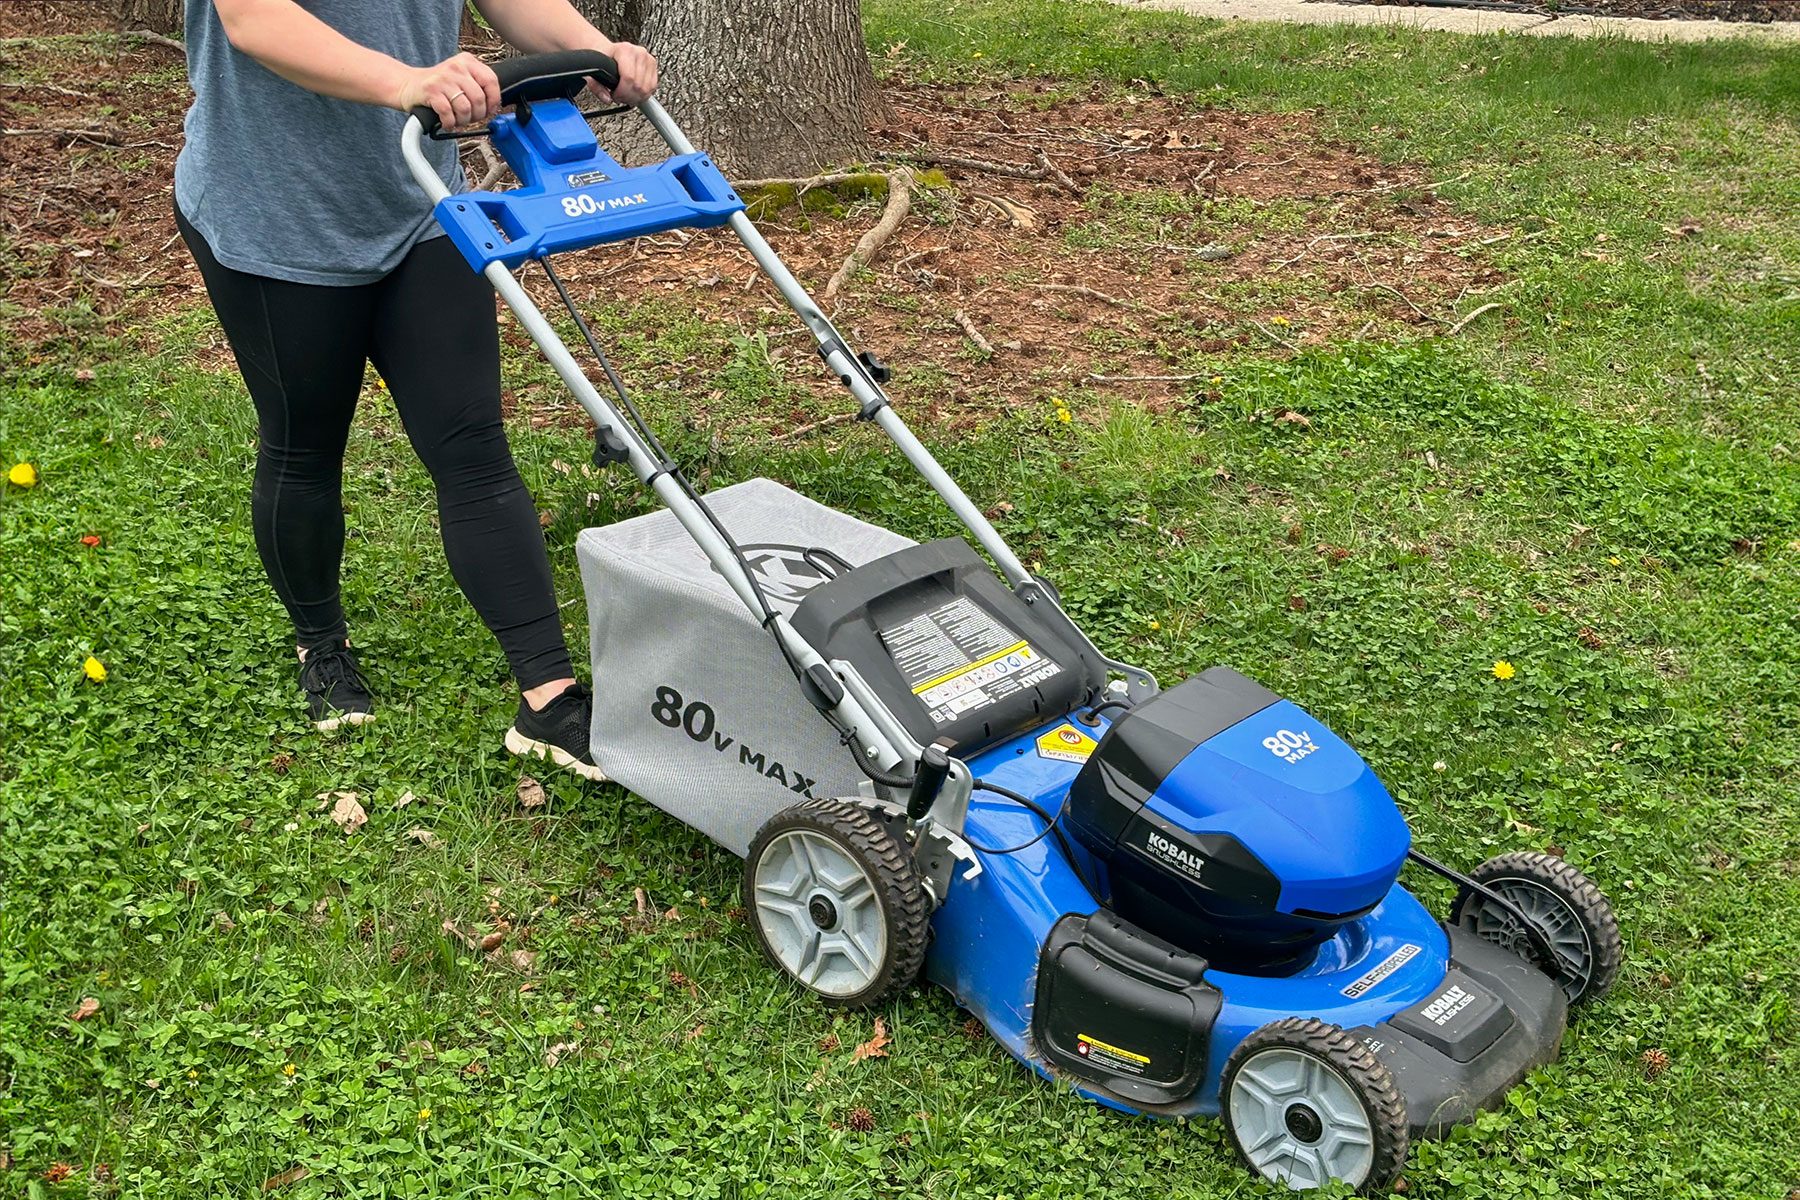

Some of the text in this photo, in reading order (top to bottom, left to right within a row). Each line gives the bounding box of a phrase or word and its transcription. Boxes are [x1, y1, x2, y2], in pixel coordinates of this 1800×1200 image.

[607, 193, 648, 209] MAX
[1284, 742, 1320, 764] MAX
[739, 744, 816, 799] MAX
[1146, 844, 1201, 879] BRUSHLESS
[1148, 831, 1204, 871] KOBALT
[1344, 945, 1418, 998] SELF-PROPELLED
[1420, 985, 1466, 1021] KOBALT
[1434, 994, 1476, 1026] BRUSHLESS
